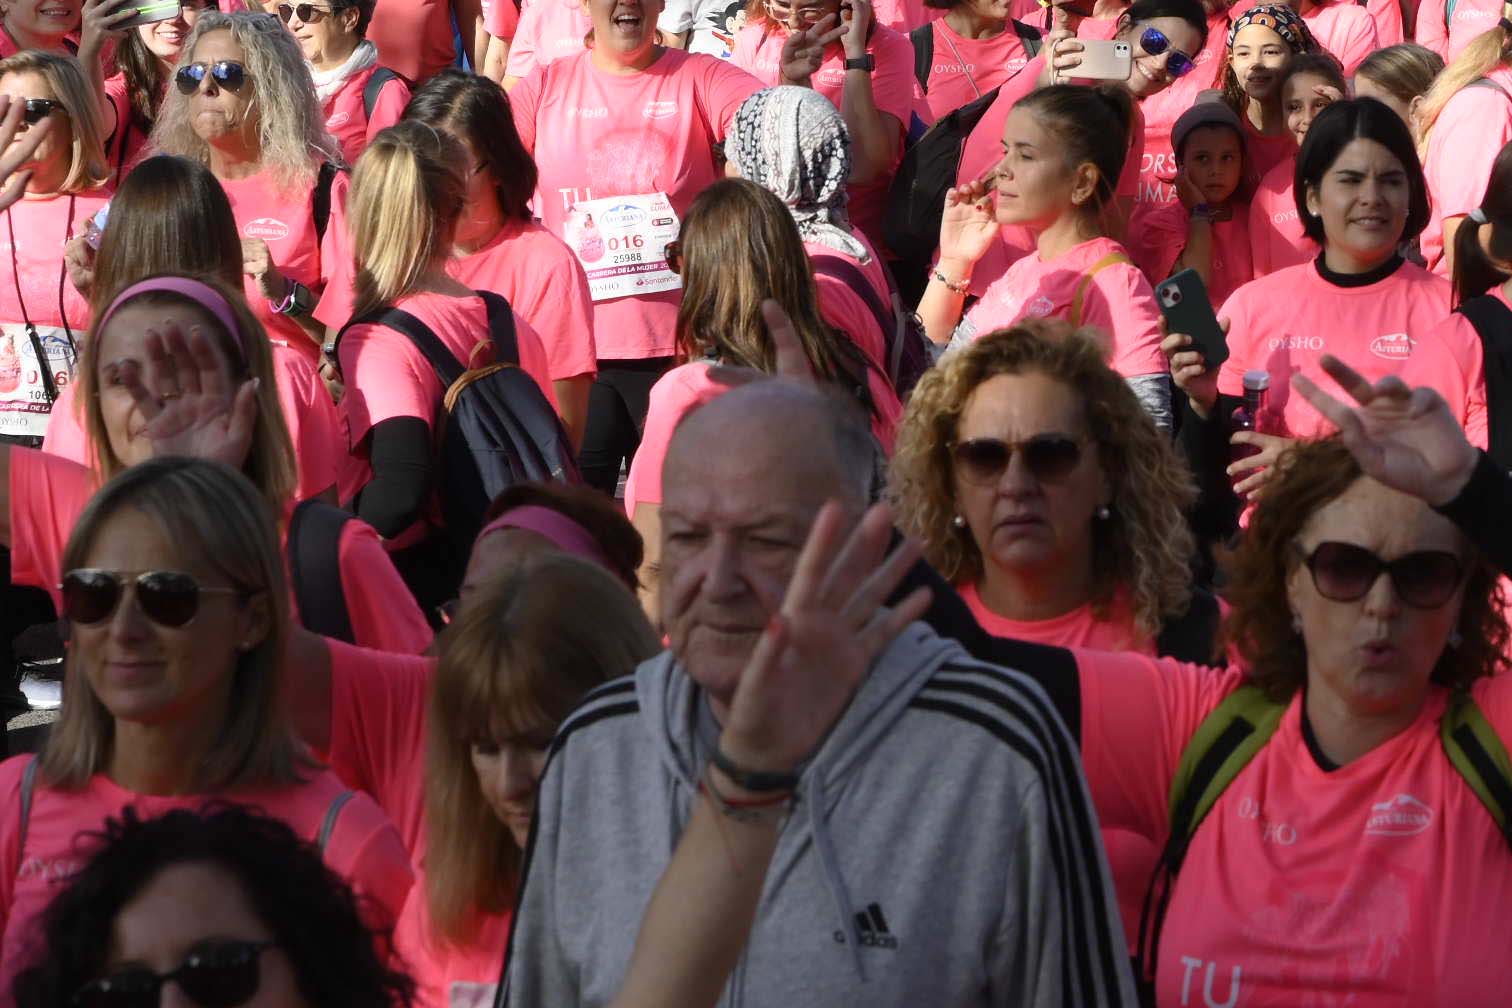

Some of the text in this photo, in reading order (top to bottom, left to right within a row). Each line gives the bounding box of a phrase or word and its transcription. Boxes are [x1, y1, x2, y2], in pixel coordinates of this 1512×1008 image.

[933, 63, 974, 74] OYSHO
[608, 234, 644, 251] 016
[613, 252, 642, 264] 25988
[1268, 336, 1324, 350] OYSHO
[29, 390, 49, 400] 106
[1181, 955, 1241, 1008] TU
